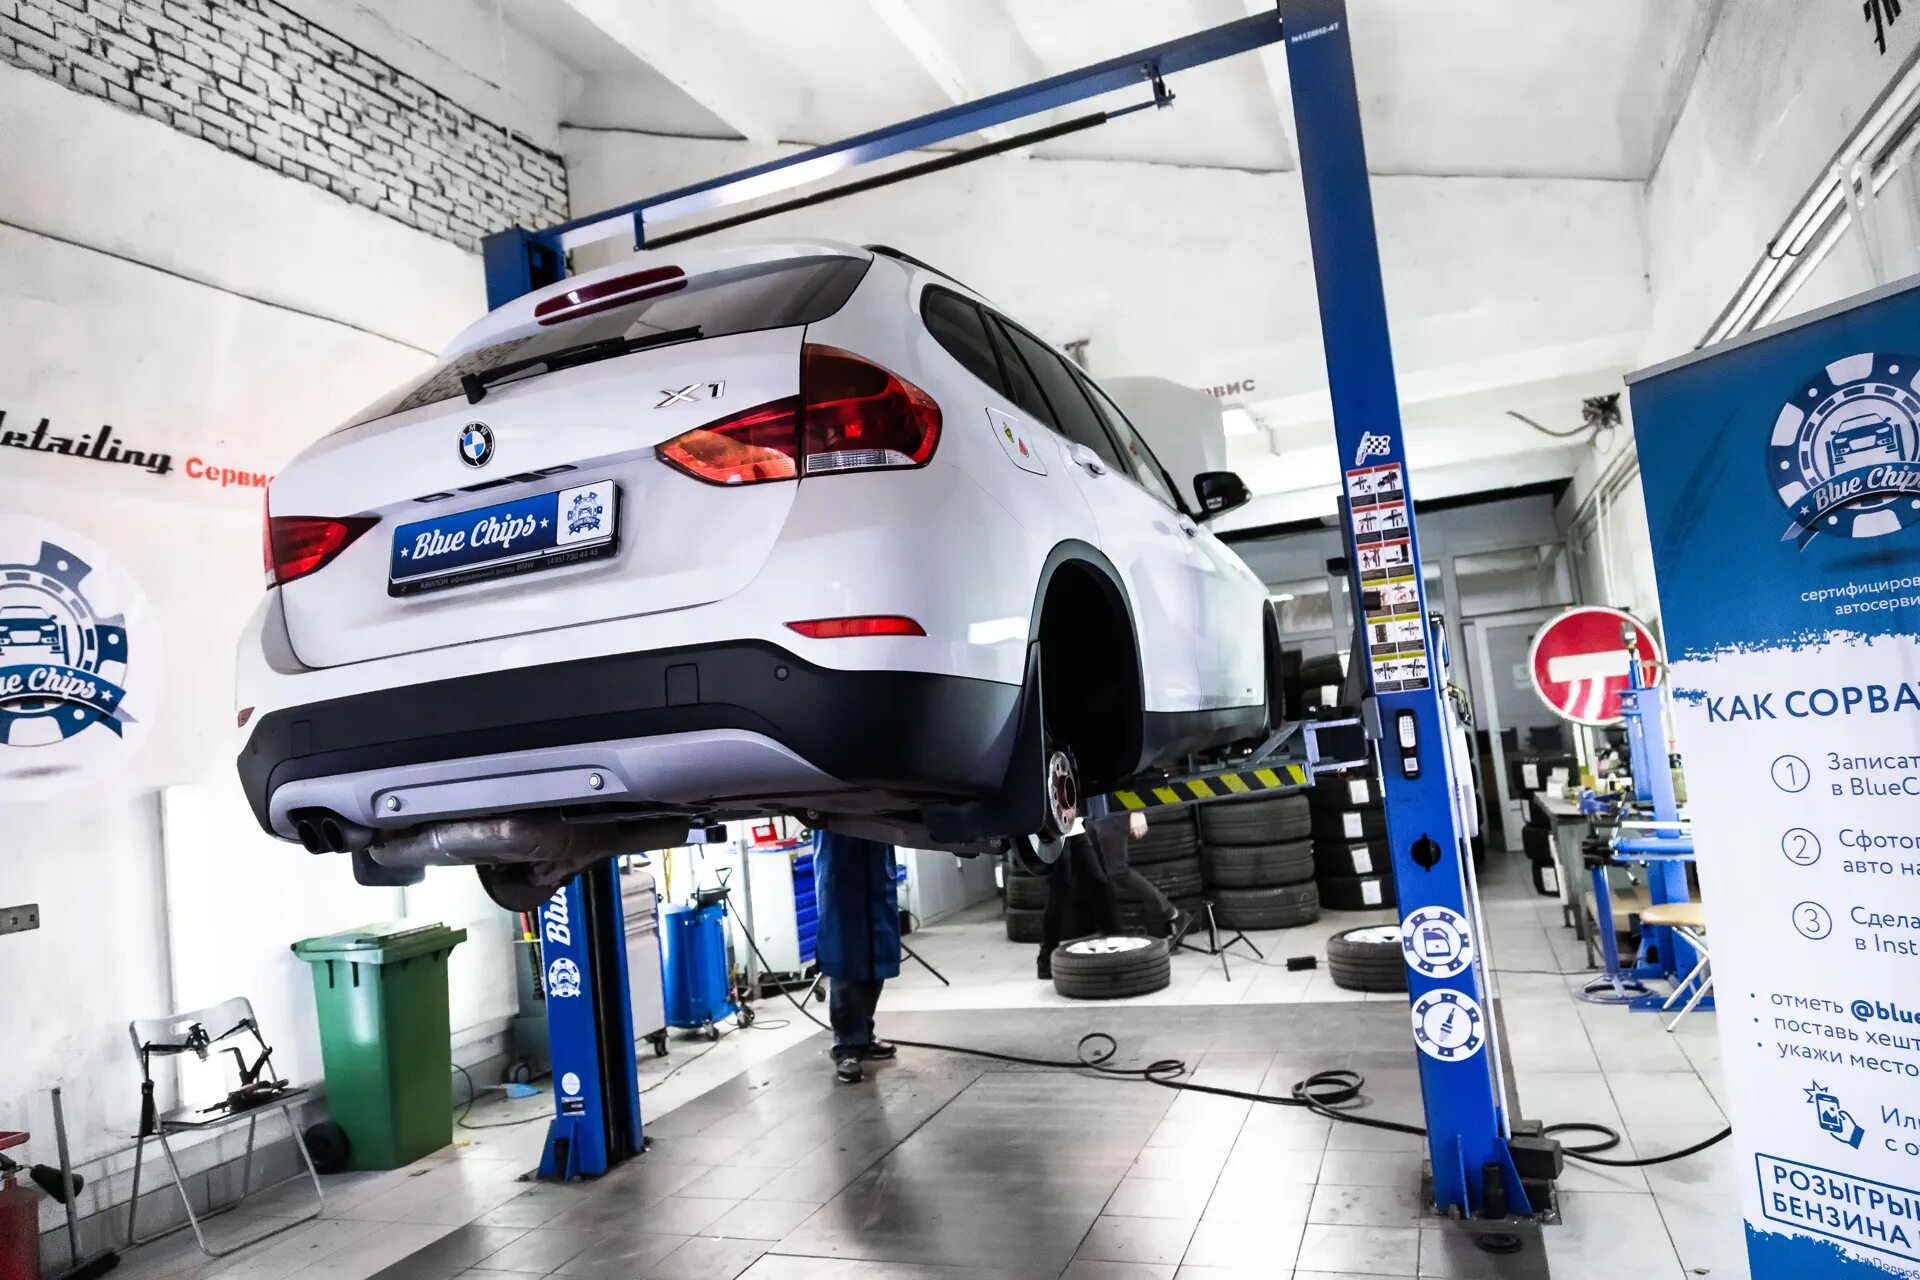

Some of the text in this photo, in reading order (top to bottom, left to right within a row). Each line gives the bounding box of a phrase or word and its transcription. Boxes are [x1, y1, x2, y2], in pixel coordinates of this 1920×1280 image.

[1813, 476, 1862, 511] Blue
[411, 513, 536, 561] Blue Chips
[28, 667, 97, 700] Chips
[1706, 692, 1777, 723] КАК
[1832, 776, 1920, 796] в BlueC
[1844, 860, 1894, 875] авто
[1855, 934, 1919, 955] в Inst
[1771, 993, 1844, 1014] отметь
[1775, 1017, 1859, 1041] поставь
[1777, 1042, 1919, 1077] укажи место
[1885, 1138, 1898, 1152] с
[1773, 1164, 1920, 1222] РОЗЫГРЫ
[1772, 1192, 1912, 1248] БЕНЗИНА
